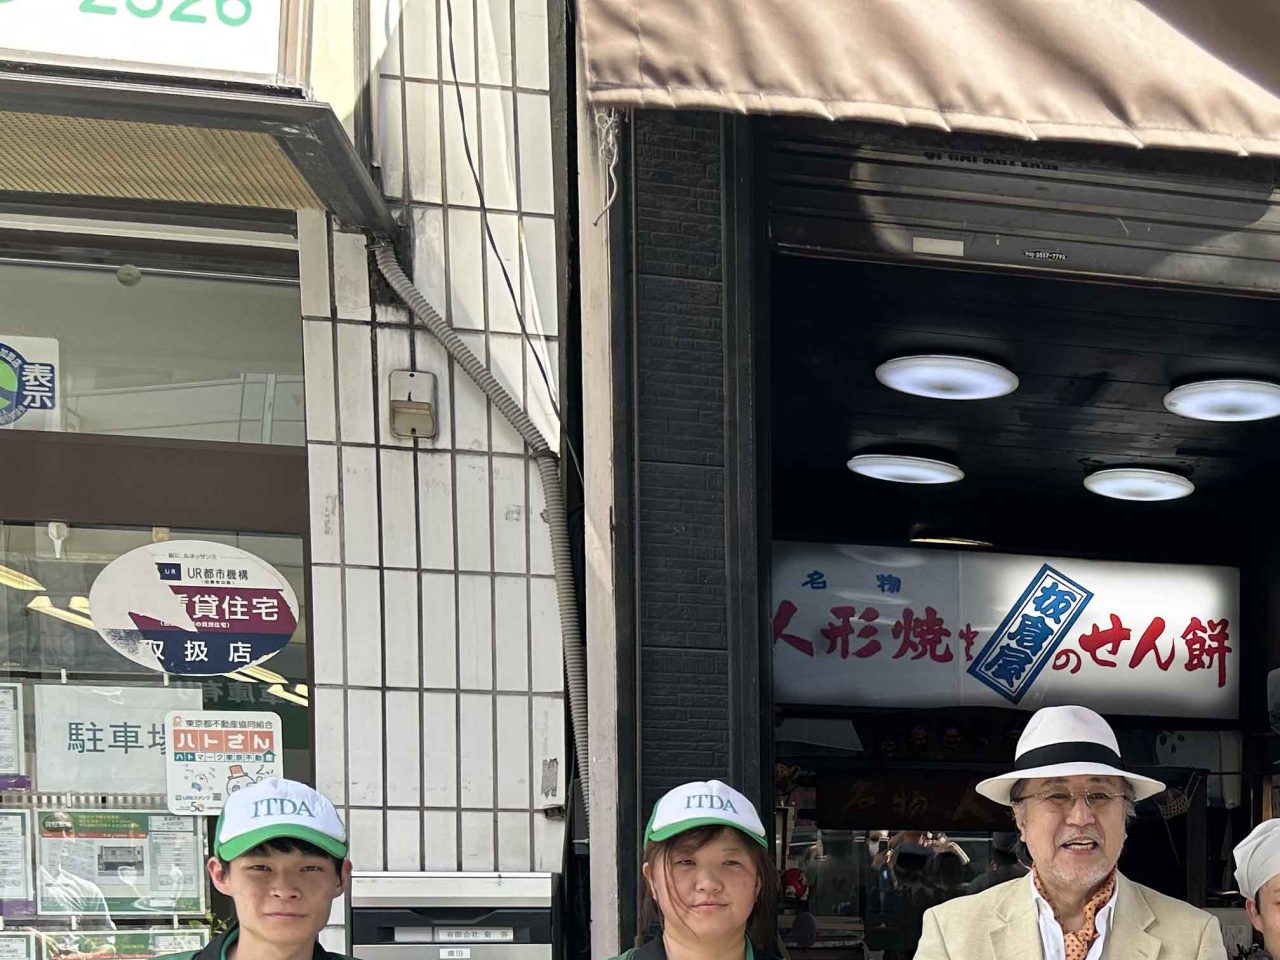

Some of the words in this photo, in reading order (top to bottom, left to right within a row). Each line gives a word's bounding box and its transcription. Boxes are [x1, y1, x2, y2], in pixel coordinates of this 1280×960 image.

[22, 364, 53, 407] 表示
[187, 567, 249, 581] UR都市機構
[801, 569, 902, 593] 名物
[1052, 612, 1232, 688] のせん餅
[186, 719, 273, 729] 東京都不動産協同組合
[177, 733, 270, 749] ハトさん
[251, 798, 314, 819] ITDA
[684, 793, 738, 815] ITDA
